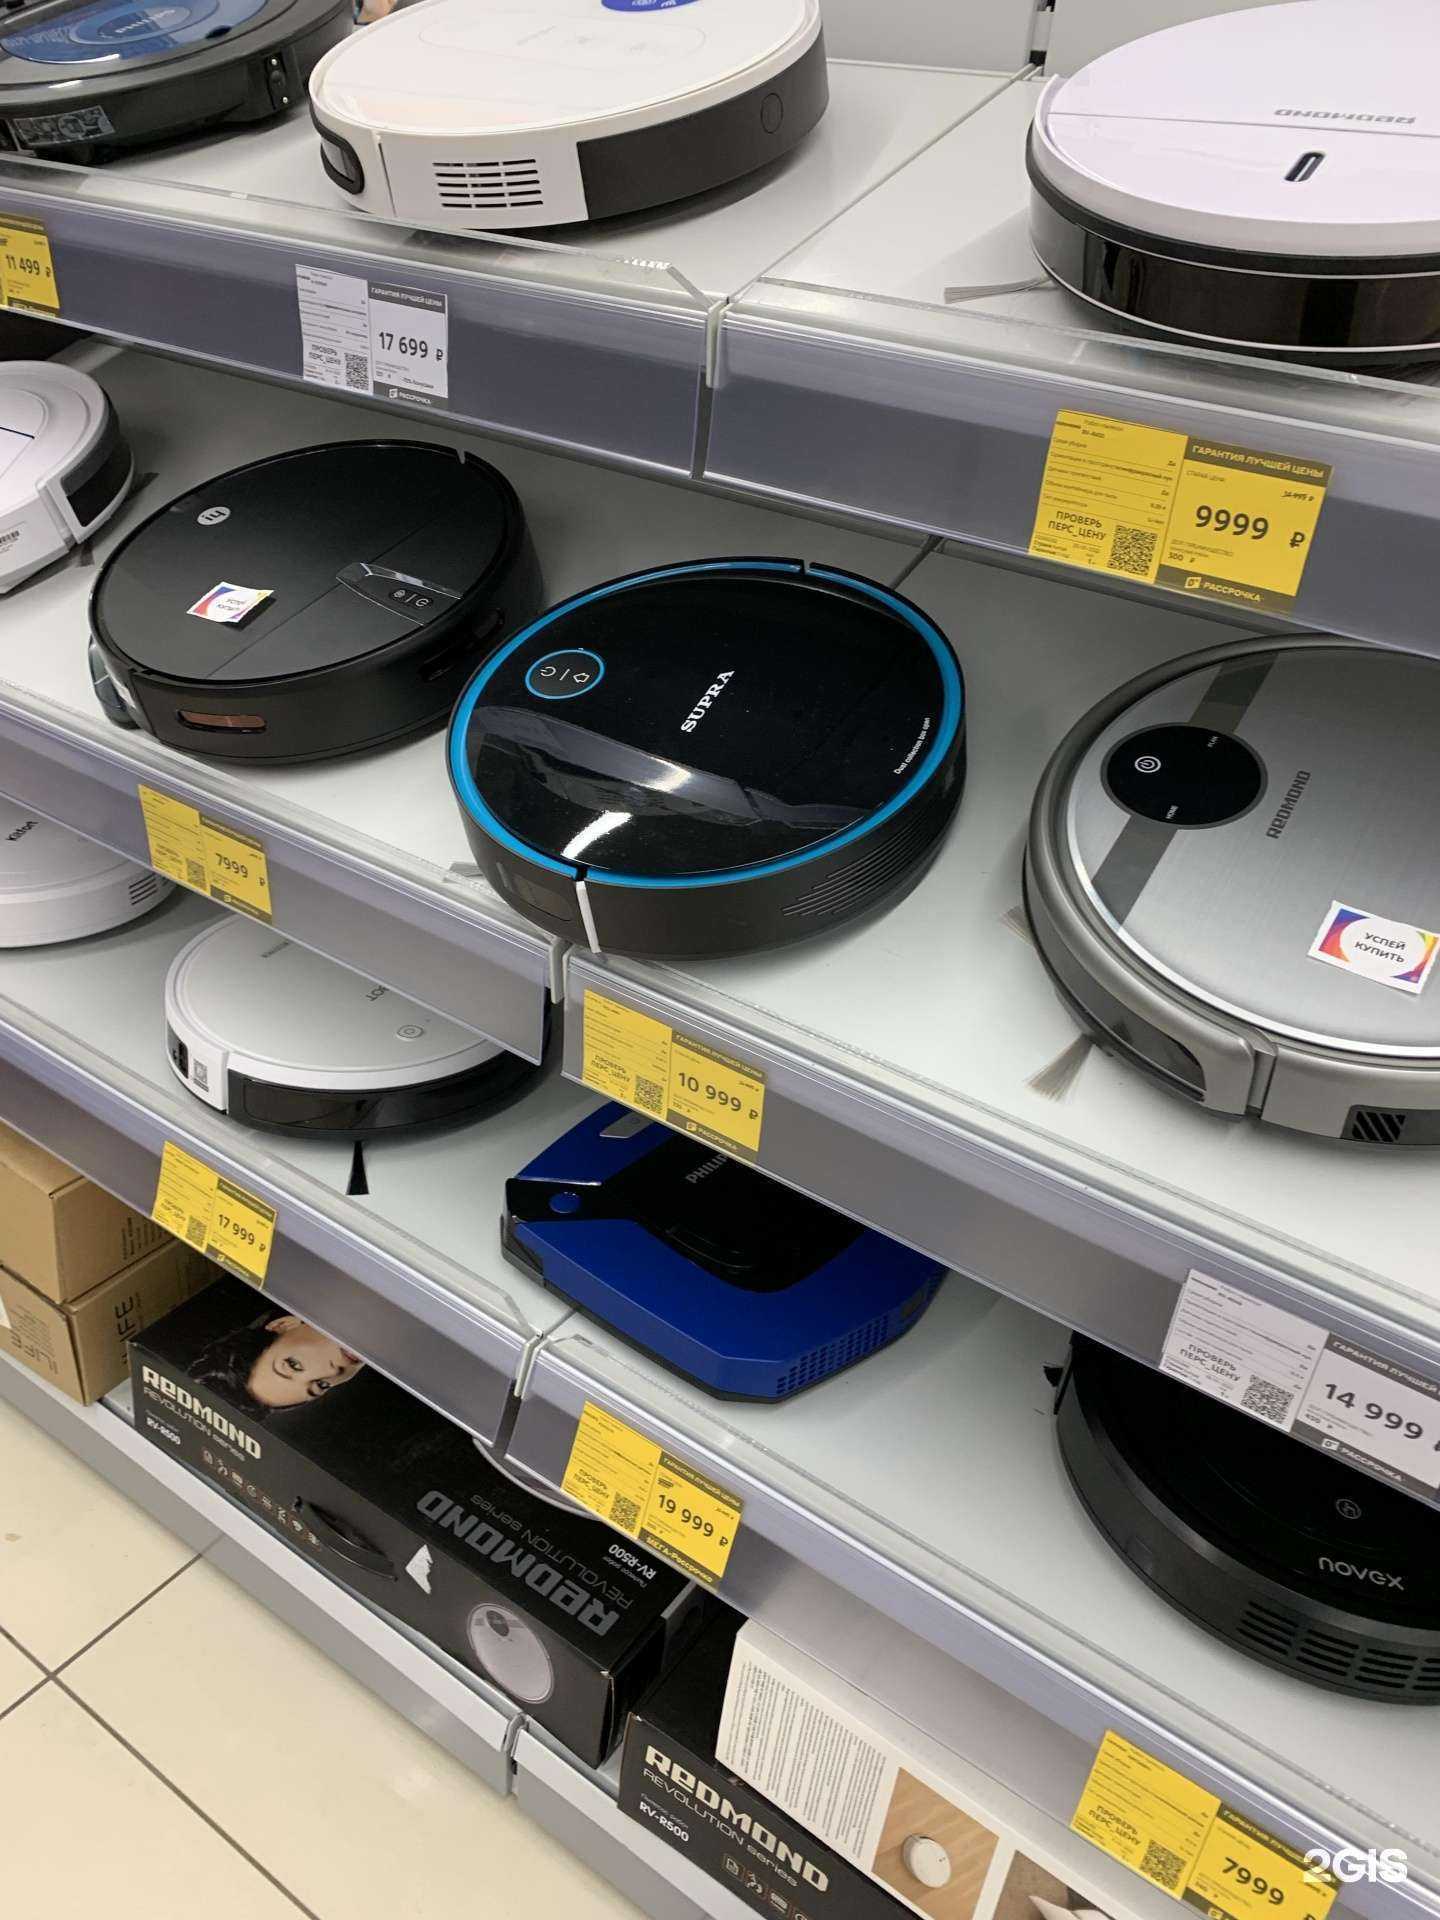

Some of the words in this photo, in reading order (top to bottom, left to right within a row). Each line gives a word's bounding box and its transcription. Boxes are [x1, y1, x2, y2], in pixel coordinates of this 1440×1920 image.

[379, 332, 393, 350] 17
[399, 337, 428, 358] 699
[1192, 445, 1245, 463] ГАРАНТИЯ
[1245, 456, 1291, 472] ЛУЧШЕЙ
[1292, 465, 1325, 479] ЦЕНЫ
[1048, 520, 1107, 541] ПЕРС_ЦЕНУ
[1055, 510, 1103, 529] ПРОВЕРЬ
[1195, 505, 1269, 540] 9999
[1203, 582, 1261, 602] РАССРОЧКА
[680, 670, 735, 732] SUPRA
[215, 853, 249, 878] 7999
[1354, 941, 1405, 963] КУПИТЬ
[1364, 932, 1407, 951] УСПЕЙ
[678, 1072, 699, 1093] 10
[706, 1085, 742, 1112] 999
[232, 1223, 255, 1245] 999
[1179, 1348, 1241, 1382] ПЕРС_ЦЕНУ
[1188, 1343, 1237, 1372] ПРОВЕРЬ
[1332, 1340, 1389, 1371] ГАРАНТИЯ
[1325, 1383, 1356, 1408] 14
[1364, 1403, 1423, 1439] 999
[1342, 1447, 1405, 1482] РАССРОЧКА
[470, 1494, 524, 1532] series
[658, 1494, 676, 1513] 19
[681, 1509, 714, 1537] 999
[521, 1529, 634, 1610] REVOLUTION
[608, 1544, 657, 1580] RV-R500
[640, 1801, 690, 1842] RV-R500
[643, 1767, 744, 1846] REVOLUTION
[746, 1844, 798, 1888] series
[1221, 1856, 1284, 1905] 7999
